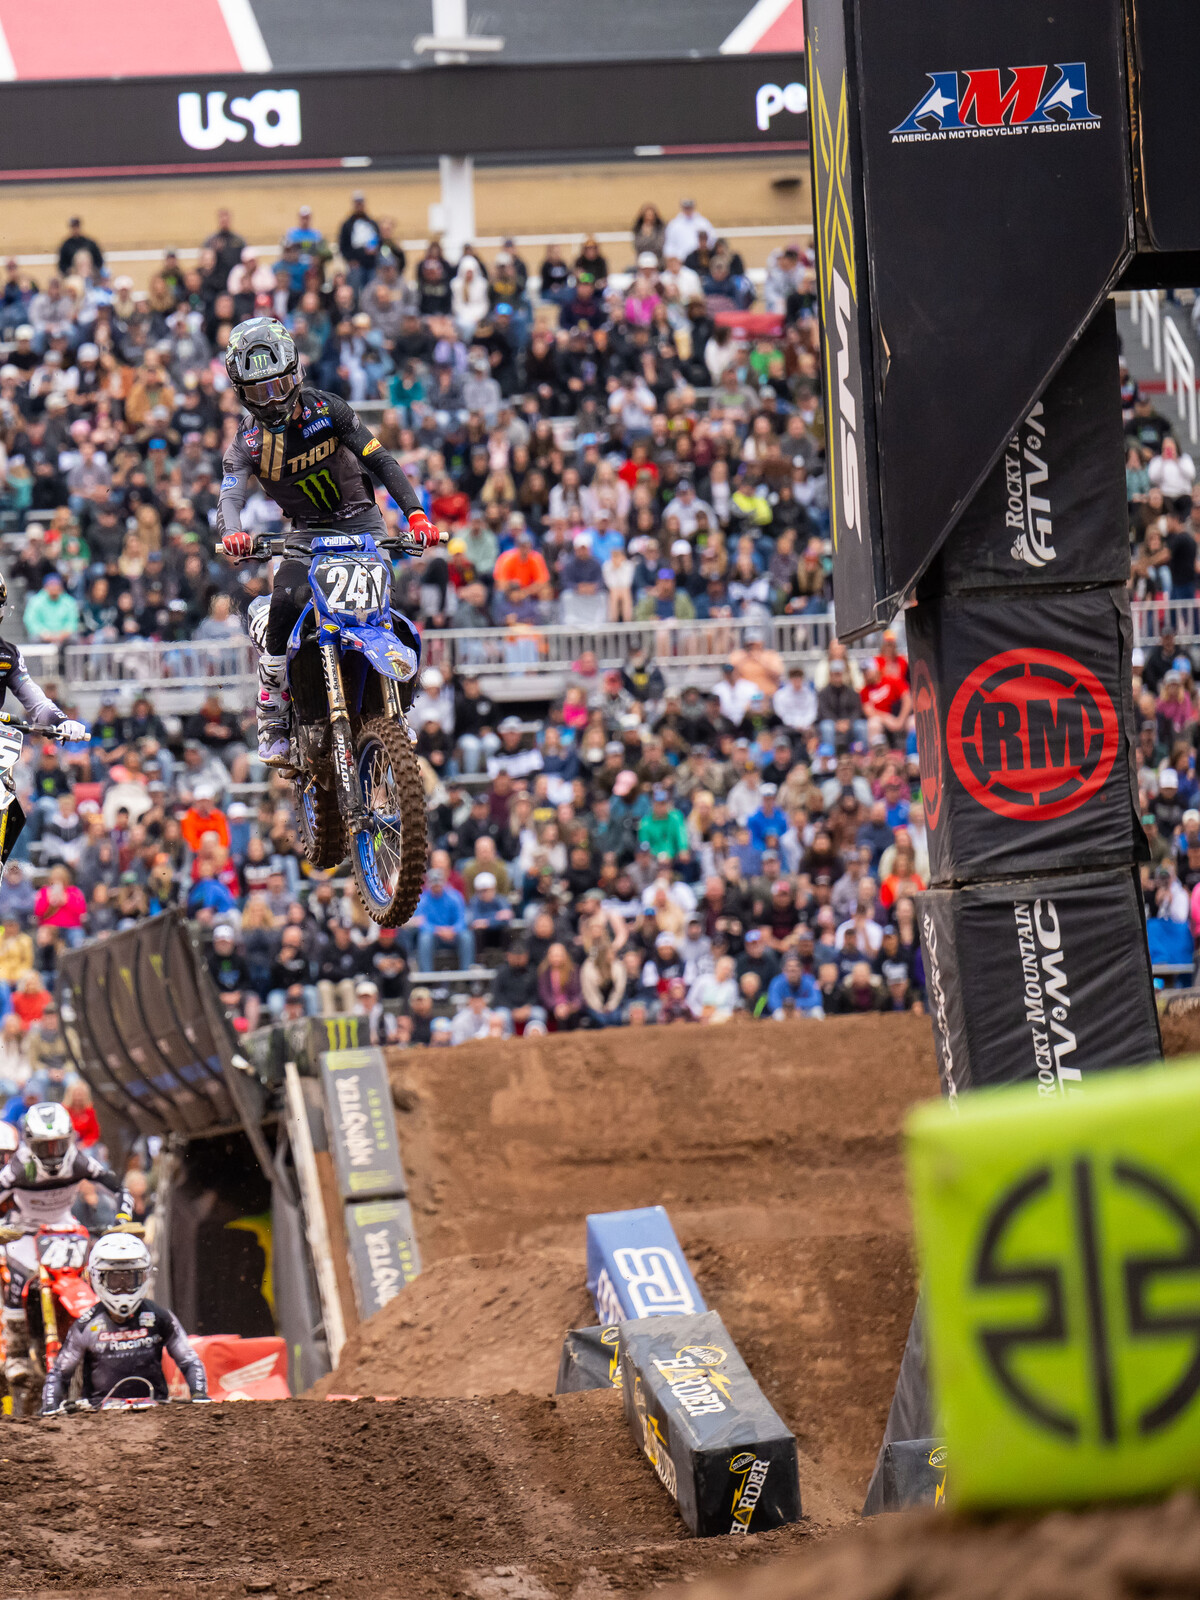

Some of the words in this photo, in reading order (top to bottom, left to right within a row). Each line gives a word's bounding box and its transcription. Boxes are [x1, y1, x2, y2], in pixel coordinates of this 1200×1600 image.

[889, 62, 1101, 134] AMA
[891, 131, 947, 143] AMERICAN
[948, 125, 1030, 139] MOTORCYCLIST
[1031, 120, 1101, 134] ASSOCIATION
[1005, 453, 1025, 531] ROCKY
[326, 563, 383, 610] 241
[336, 733, 351, 792] DUNLOP
[980, 698, 1089, 771] RM
[1014, 900, 1046, 1025] MOUNTAIN
[1031, 1027, 1057, 1099] ROCKY
[364, 1228, 401, 1308] NSTER
[730, 1459, 770, 1535] HARDER
